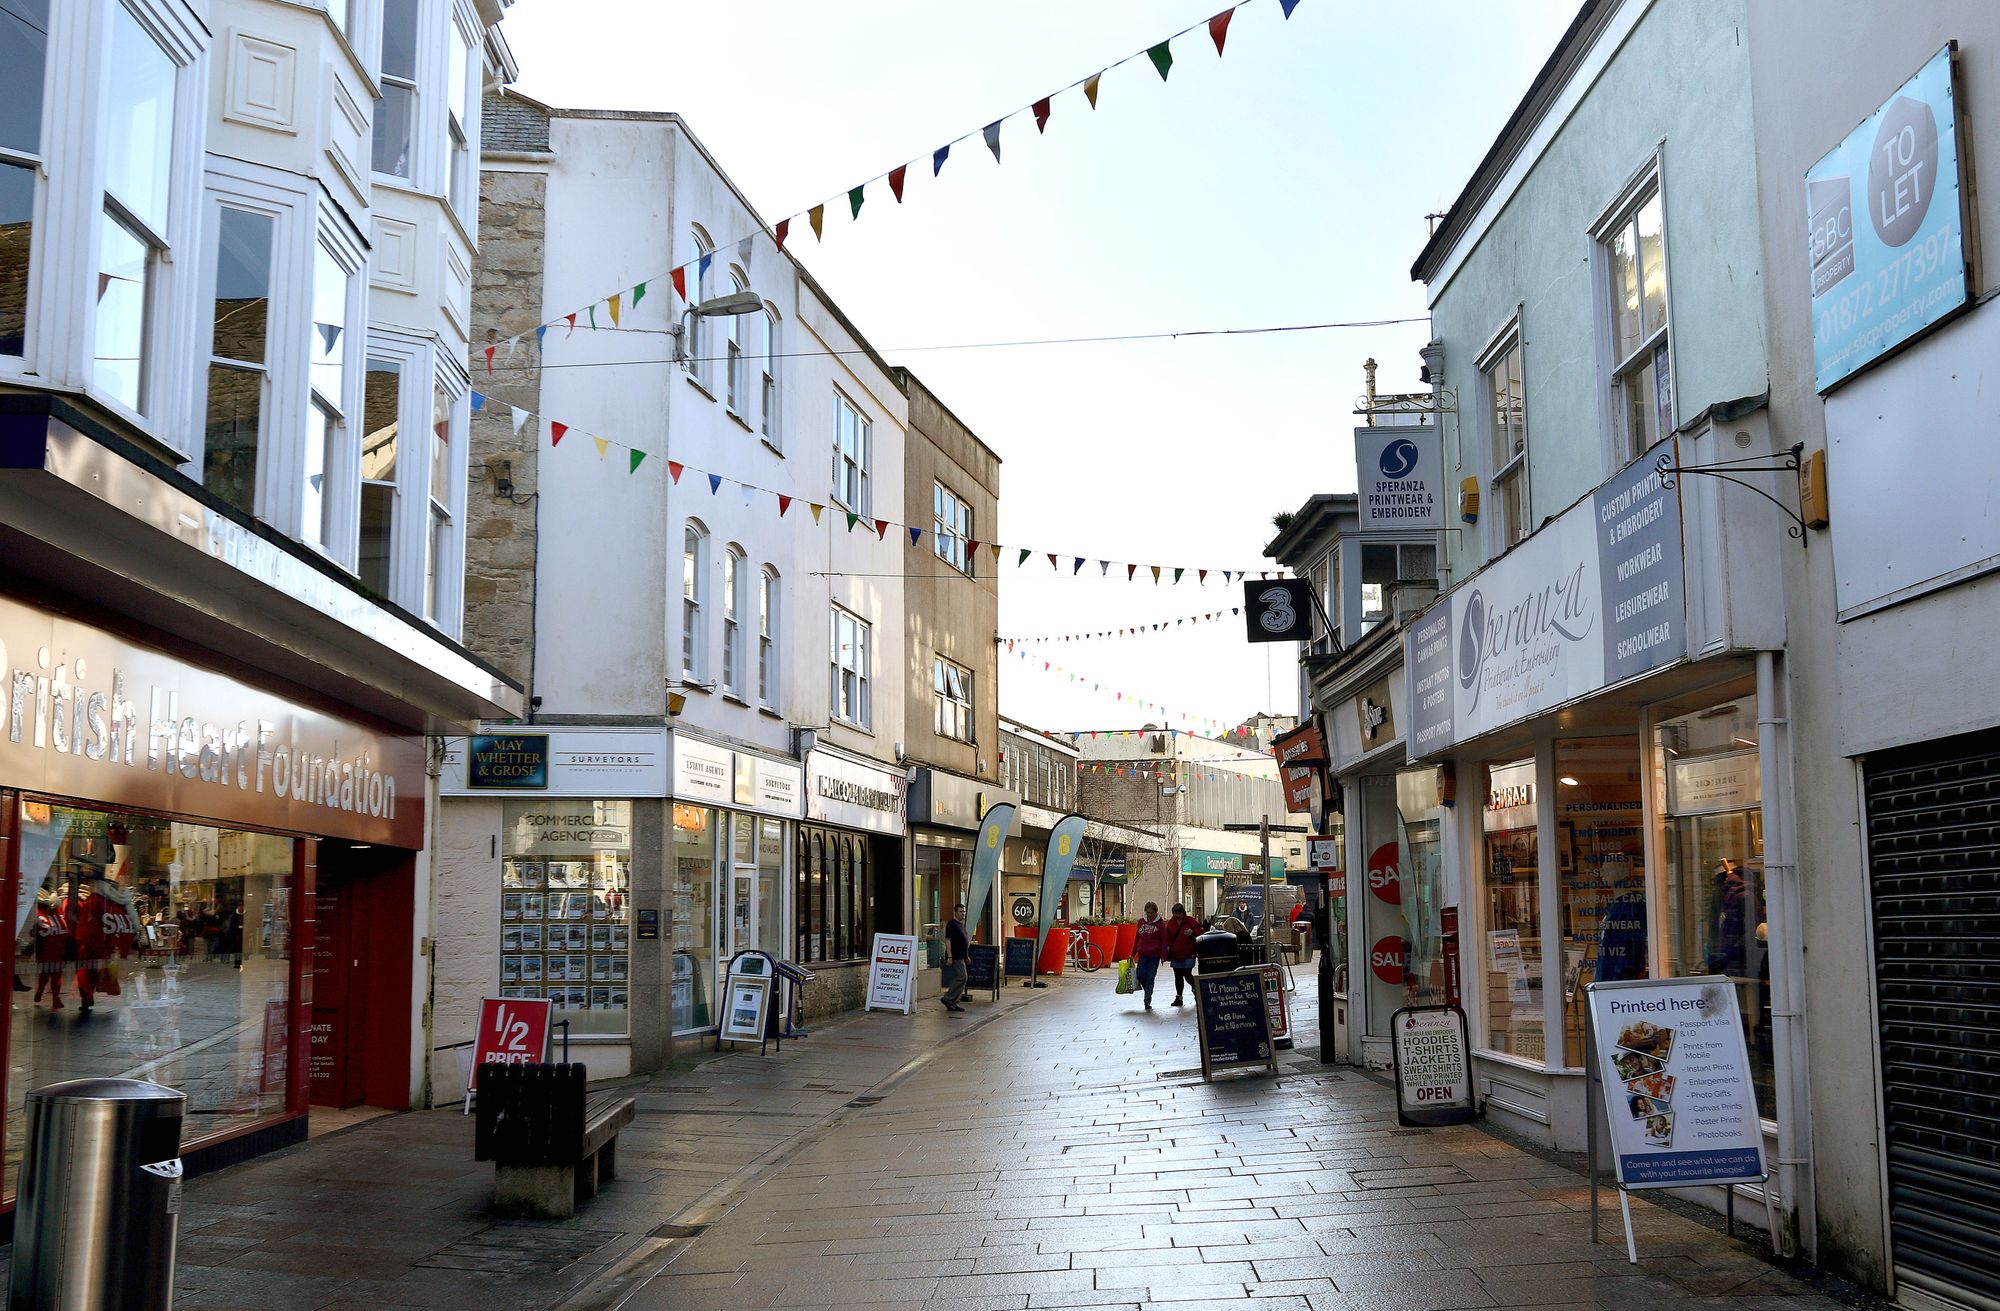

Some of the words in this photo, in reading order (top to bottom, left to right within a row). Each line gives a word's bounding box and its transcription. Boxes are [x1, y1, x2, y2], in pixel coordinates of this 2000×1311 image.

[1883, 124, 1915, 178] TO
[1881, 160, 1923, 228] LET
[1813, 206, 1850, 258] SBC
[1816, 254, 1851, 289] PROPERTY
[1820, 281, 1873, 345] 01872
[1877, 224, 1950, 308] 277397
[1821, 276, 1957, 371] www.sbcproperty.com
[1376, 480, 1425, 493] SPERANZA
[1369, 493, 1424, 506] PRINTWEAR
[1427, 493, 1434, 504] &
[1371, 505, 1432, 519] EMBROIDERY
[1601, 492, 1631, 523] CUSTOM
[1609, 528, 1616, 546] &
[1617, 496, 1664, 543] EMBROIDERY
[1617, 542, 1663, 583] WORKWEAR
[1615, 581, 1669, 623] LEISUREWEAR
[1417, 615, 1447, 645] PERSONALISED
[1460, 560, 1594, 717] Speranza
[1617, 621, 1670, 660] SCHOOLWEAR
[1417, 644, 1434, 663] CANVAS
[1433, 635, 1448, 653] PRINTS
[1416, 674, 1434, 694] INSTANT
[1434, 666, 1449, 686] PHOTOS
[1427, 689, 1445, 709] POSTERS
[0, 637, 136, 767] ritish
[147, 685, 250, 791] Heart
[255, 719, 396, 820] Foundation
[1416, 725, 1436, 744] PASSPORT
[1436, 718, 1451, 737] PHOTOS
[494, 740, 524, 751] MAY
[476, 752, 541, 764] WHETTER
[478, 766, 489, 776] &
[492, 765, 537, 777] GROSE
[686, 760, 704, 773] ESTATE
[705, 765, 724, 776] AGENTS
[765, 779, 791, 791] SURVEYORS
[1566, 801, 1643, 812] PERSONALISED
[541, 831, 595, 841] AGENCY
[1573, 827, 1638, 838] EMBROIDERY
[1206, 855, 1234, 870] Poundland
[1569, 880, 1608, 890] SCHOOL
[1614, 879, 1644, 889] WEAR
[1622, 894, 1647, 903] CAPS
[1014, 905, 1032, 917] 60%
[881, 944, 909, 955] CAFÉ
[1608, 947, 1626, 957] VIZ
[1208, 982, 1218, 994] 12
[1611, 999, 1667, 1014] Printed
[1671, 998, 1710, 1012] here:
[1403, 1035, 1457, 1046] HOODIES
[1403, 1044, 1459, 1056] T-SHIRTS
[1403, 1053, 1461, 1066] JACKETS
[1403, 1063, 1462, 1075] SWEATSHIRTS
[1404, 1073, 1433, 1081] CUSTOM
[1433, 1072, 1463, 1080] PRINTED
[1689, 1076, 1740, 1086] Enlargements
[1416, 1086, 1453, 1101] OPEN
[1693, 1104, 1720, 1112] Canvas
[1698, 1130, 1742, 1139] Photobooks
[1627, 1161, 1651, 1169] Come
[1661, 1159, 1676, 1167] and
[1694, 1157, 1713, 1165] what
[1640, 1170, 1658, 1178] with
[1658, 1170, 1676, 1179] your
[1678, 1168, 1712, 1176] favourite
[1713, 1166, 1745, 1176] images!
